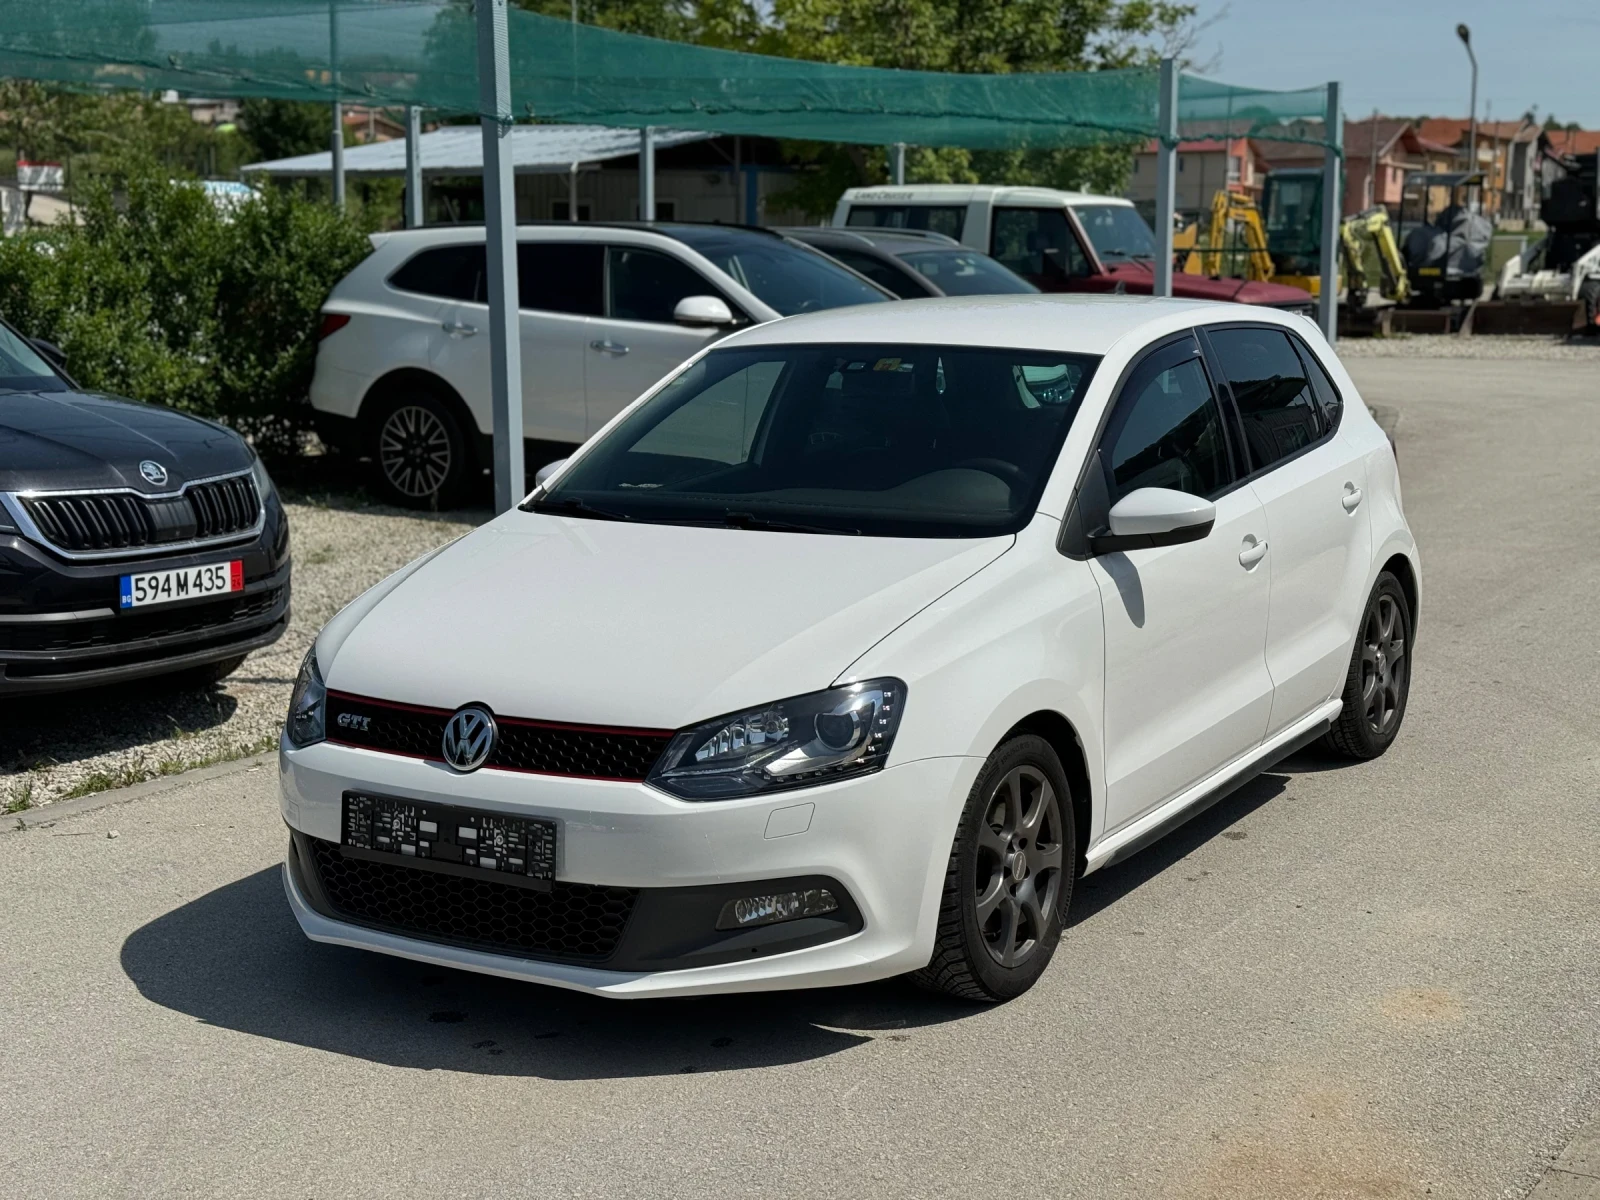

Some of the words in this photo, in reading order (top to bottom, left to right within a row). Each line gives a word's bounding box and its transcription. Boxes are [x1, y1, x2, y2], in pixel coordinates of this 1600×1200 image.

[134, 574, 172, 602] 594
[176, 571, 189, 597] M
[192, 565, 226, 592] 435
[122, 594, 132, 604] BG
[337, 712, 371, 732] GTI
